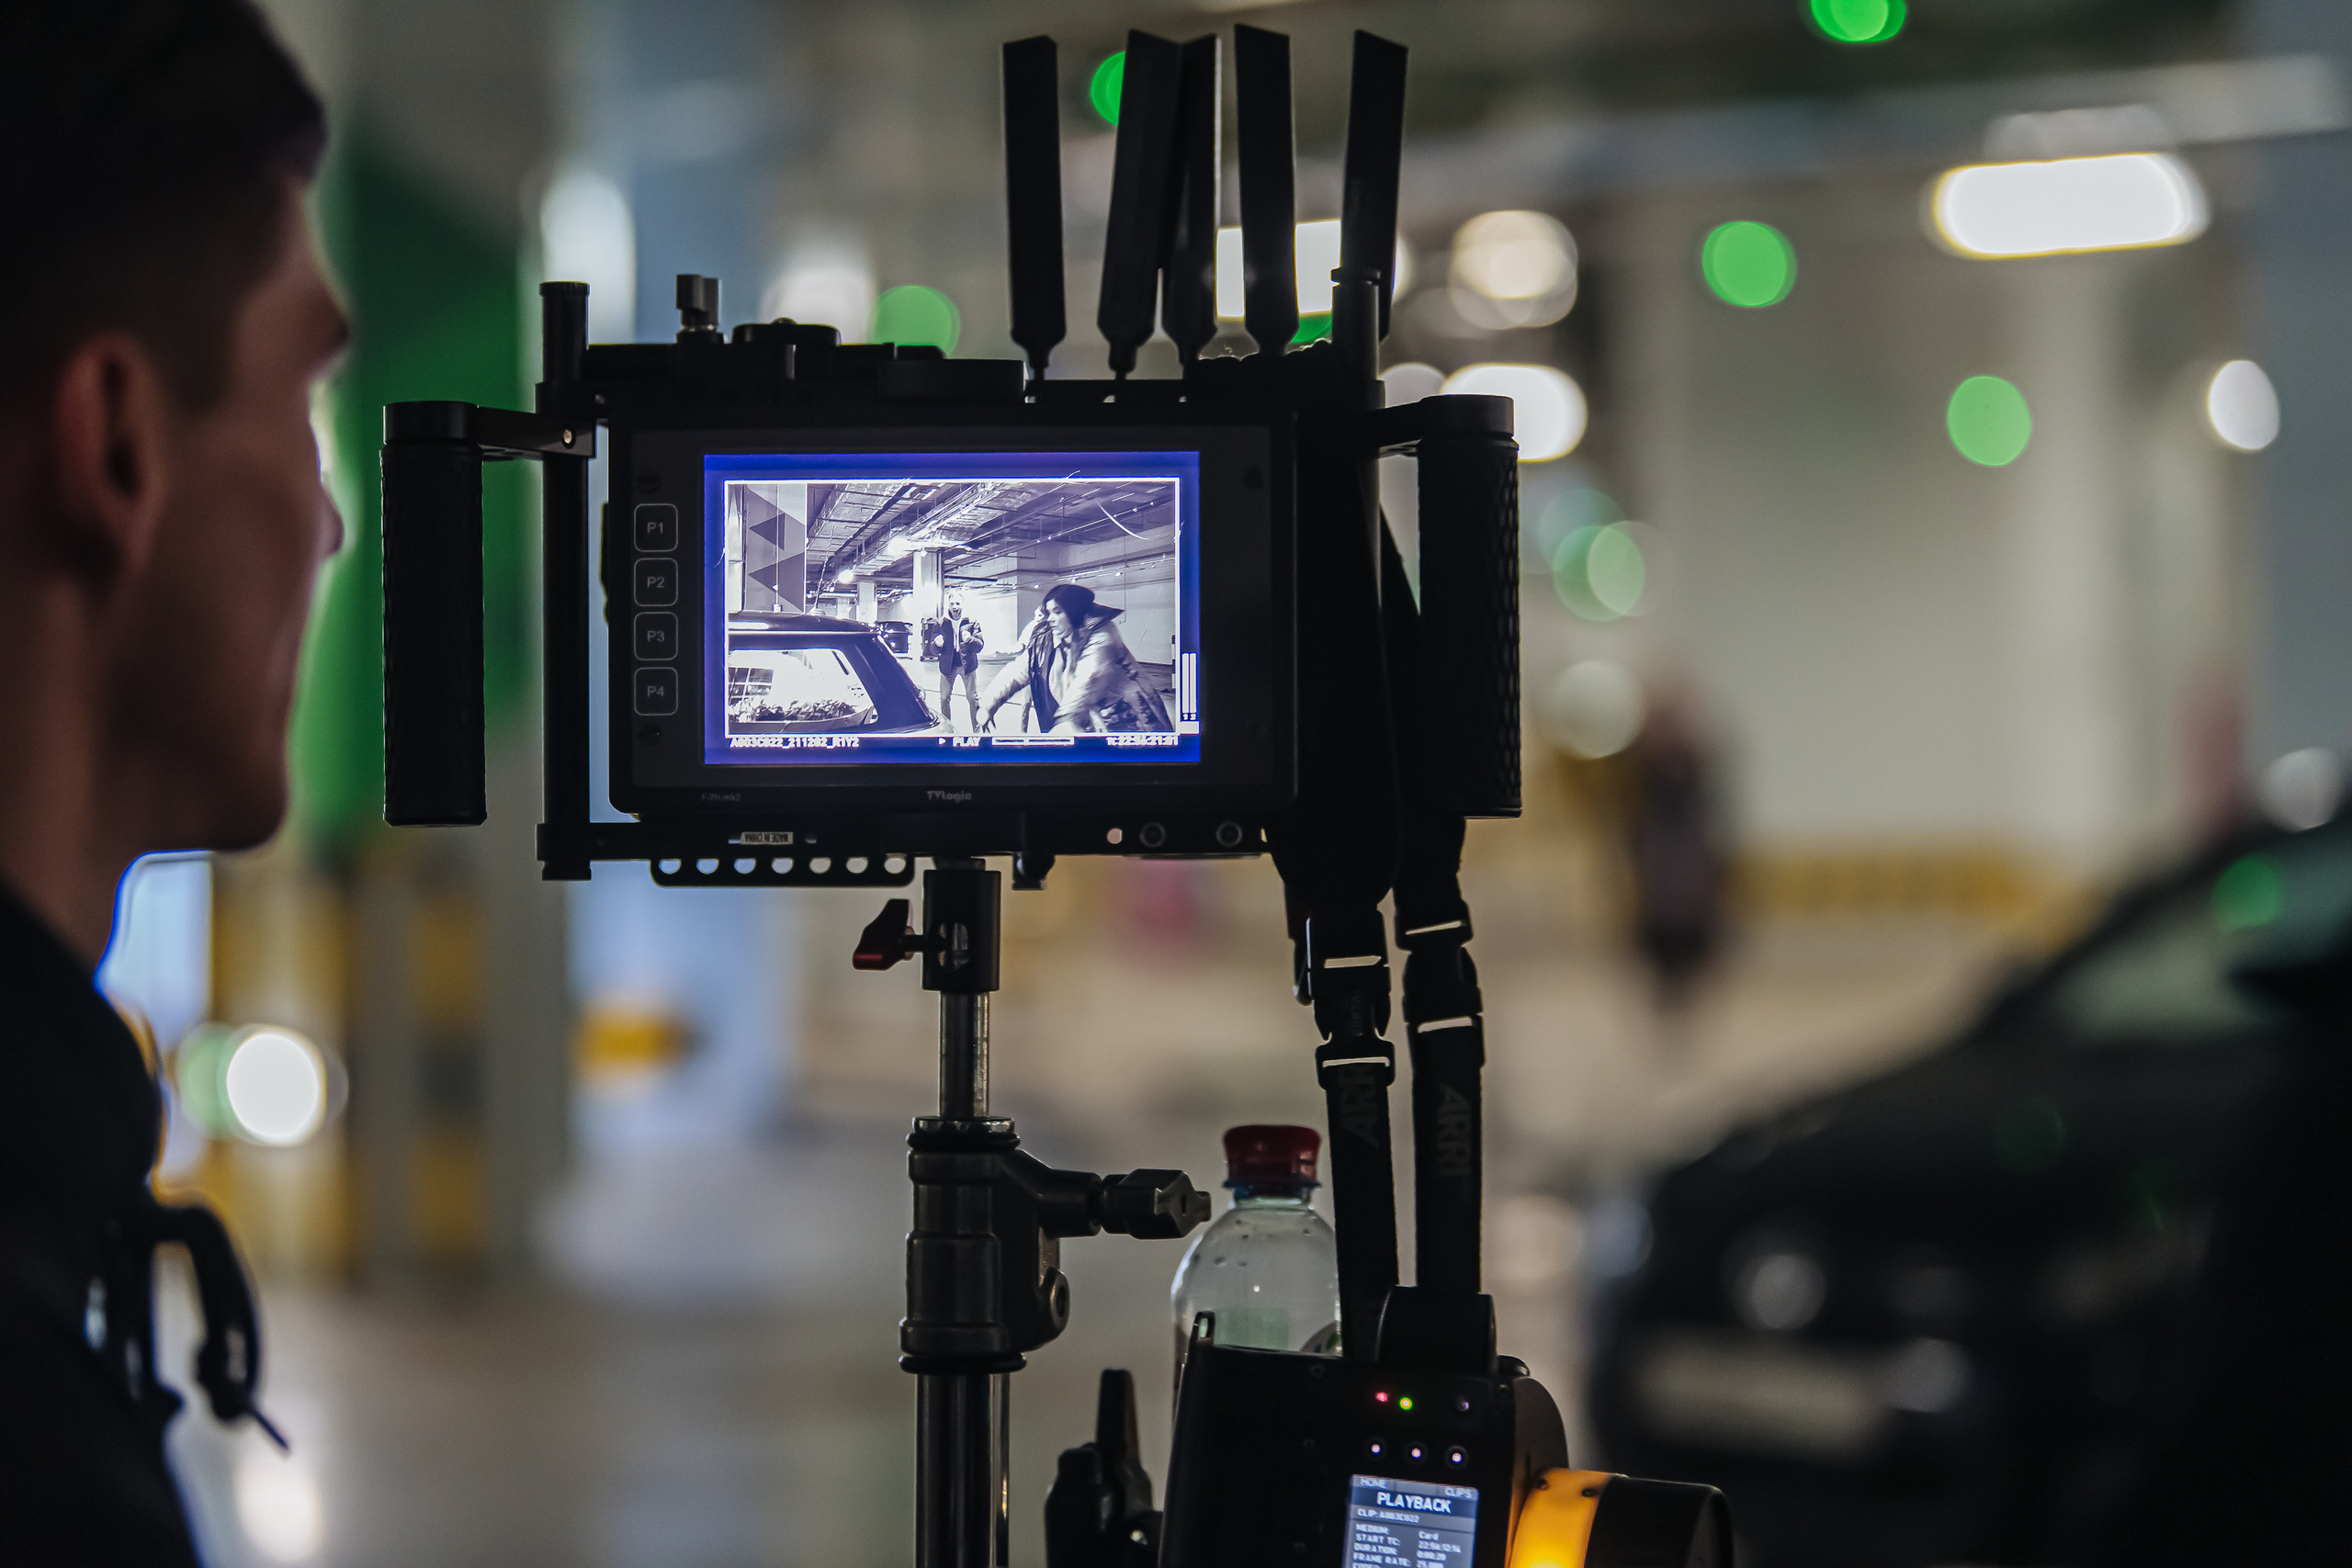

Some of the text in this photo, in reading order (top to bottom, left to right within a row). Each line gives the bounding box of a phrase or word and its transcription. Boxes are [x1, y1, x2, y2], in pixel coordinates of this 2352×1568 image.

[647, 522, 663, 533] P1
[647, 576, 665, 588] P2
[647, 630, 665, 642] P3
[647, 685, 665, 696] P4
[952, 737, 981, 748] PLAY
[926, 790, 973, 804] TVLogic
[771, 832, 789, 842] MADE
[1437, 1082, 1472, 1177] ARRI
[1444, 1487, 1473, 1499] CLIPS
[1376, 1491, 1452, 1514] PLAYBACK
[1355, 1533, 1385, 1544] START
[1352, 1551, 1384, 1563] FRAME
